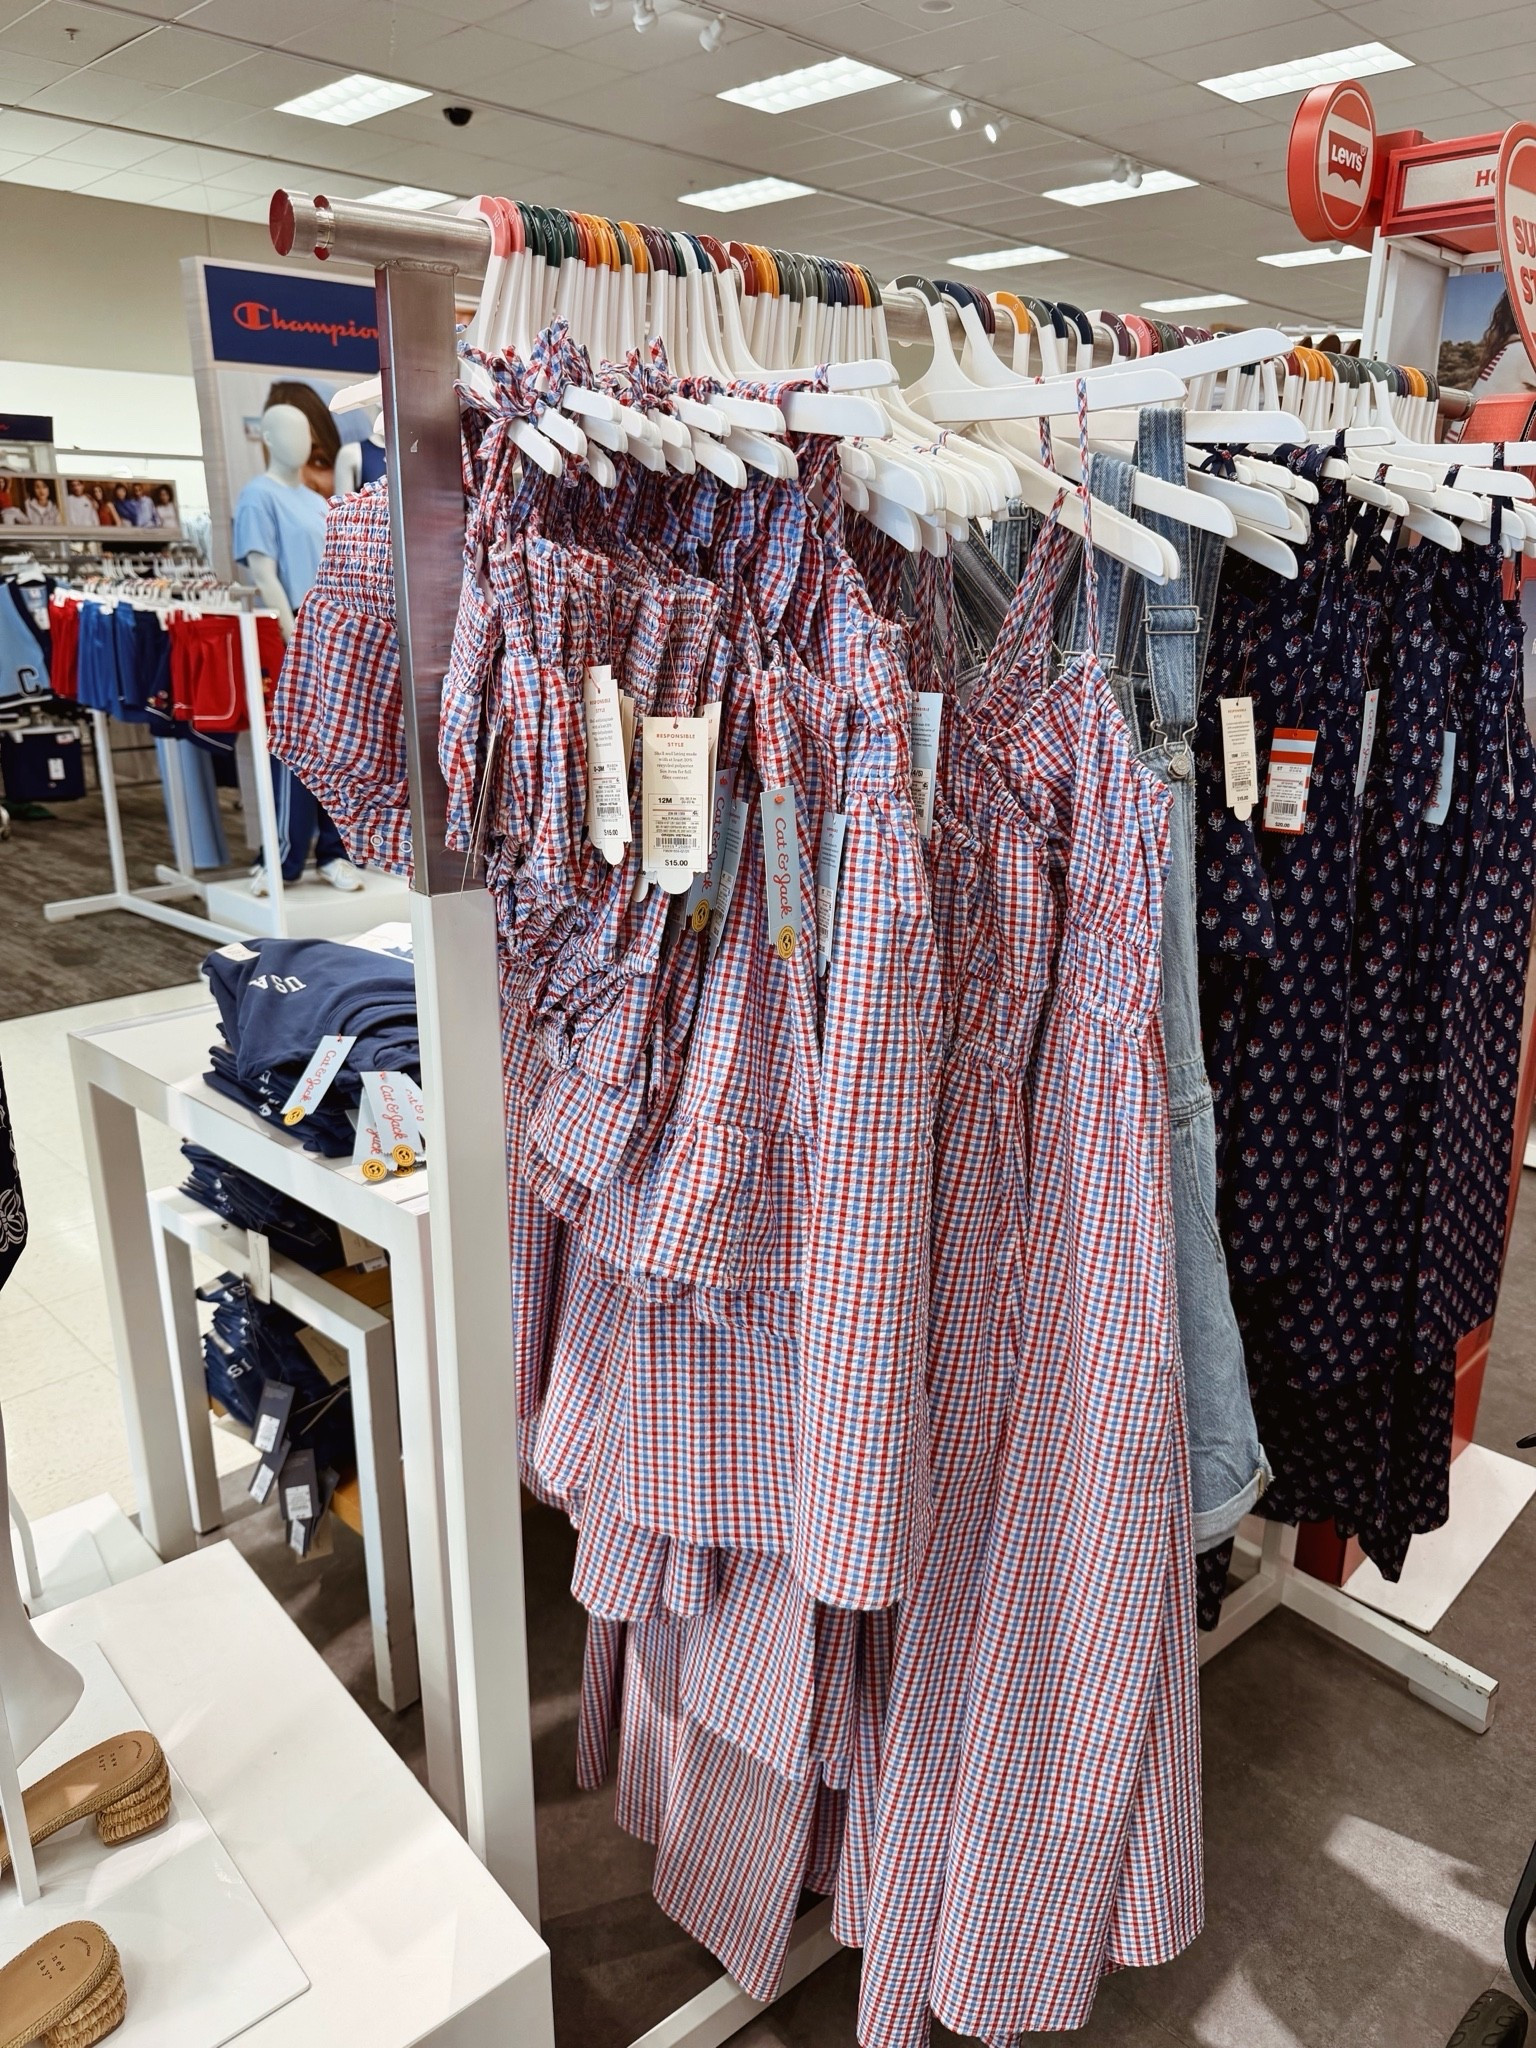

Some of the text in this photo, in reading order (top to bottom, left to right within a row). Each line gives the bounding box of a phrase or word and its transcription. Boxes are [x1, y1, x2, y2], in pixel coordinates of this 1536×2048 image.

[706, 239, 716, 251] XS
[740, 255, 749, 271] XS
[916, 279, 924, 288] M
[944, 283, 950, 292] L
[1029, 300, 1036, 310] M
[1114, 322, 1121, 335] XL
[1384, 368, 1392, 377] M
[17, 665, 41, 697] C
[714, 797, 725, 826] Cat
[603, 828, 619, 836] $15.00
[775, 817, 787, 851] Cat
[664, 859, 689, 867] $15.00
[778, 852, 790, 871] &
[773, 872, 793, 919] Jack
[248, 974, 307, 993] USA
[320, 1050, 336, 1067] Cat
[300, 1077, 321, 1102] Jack
[380, 1085, 394, 1103] Cat
[382, 1112, 408, 1140] Jack
[52, 1955, 66, 1972] new
